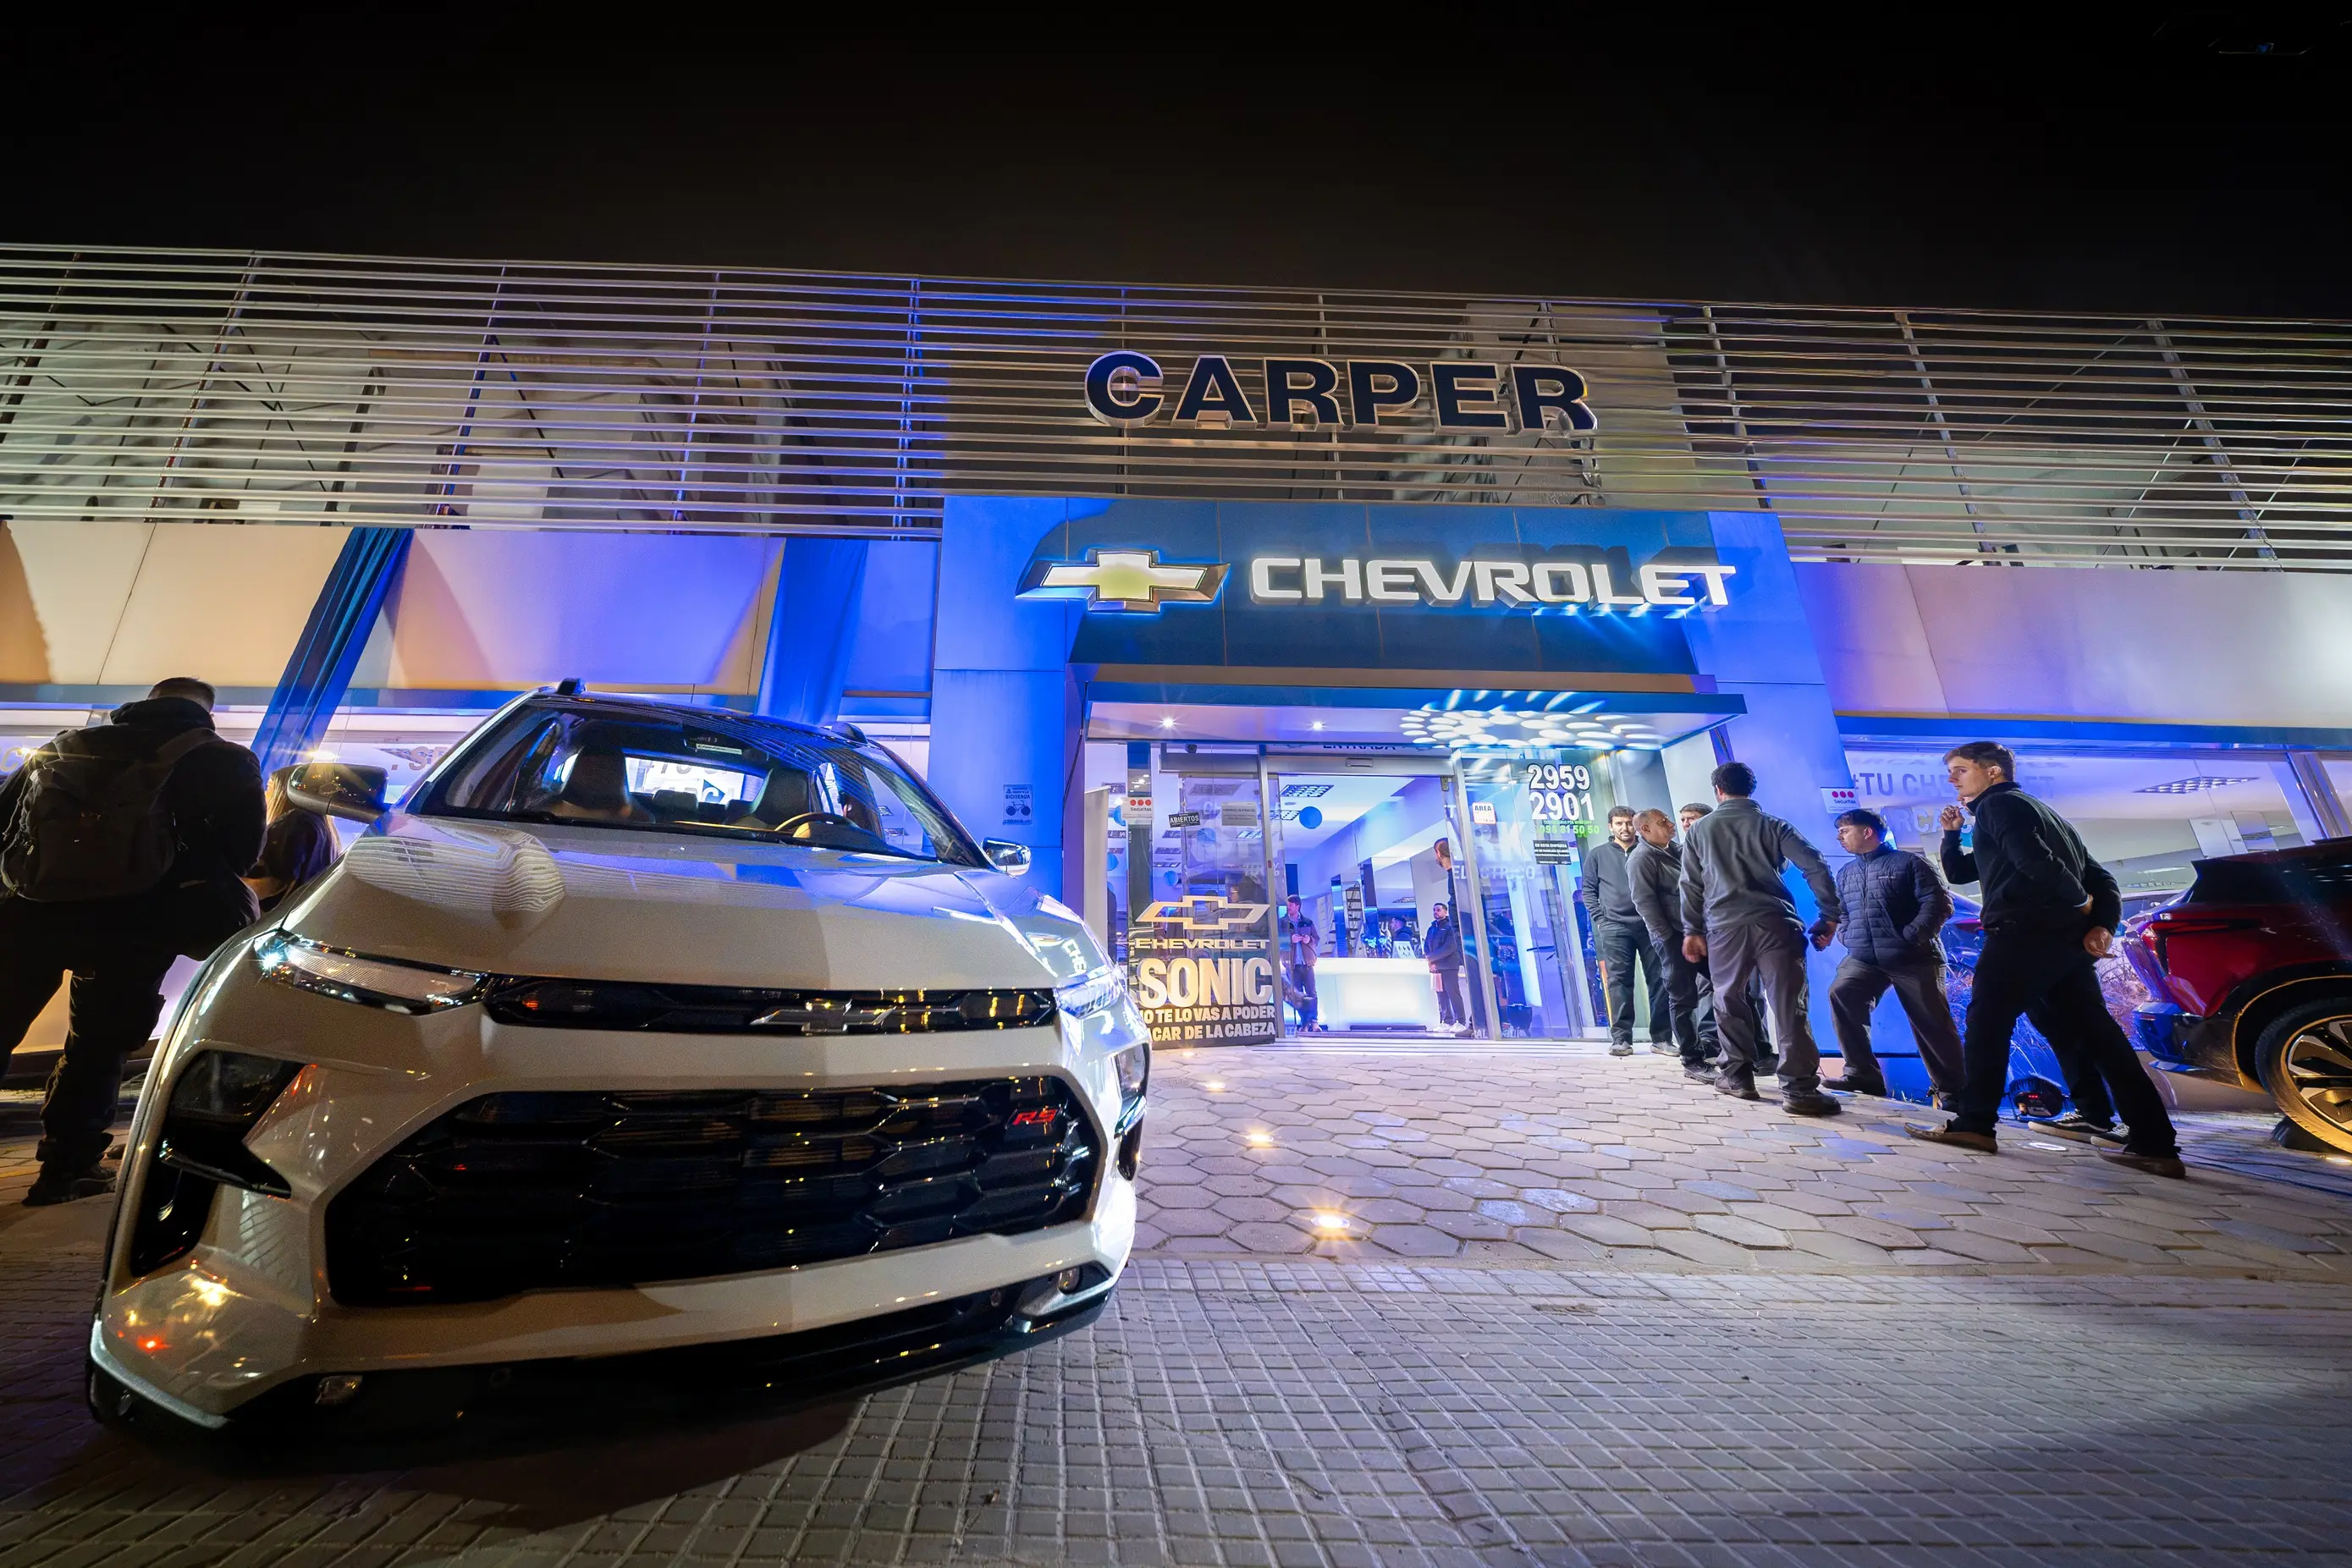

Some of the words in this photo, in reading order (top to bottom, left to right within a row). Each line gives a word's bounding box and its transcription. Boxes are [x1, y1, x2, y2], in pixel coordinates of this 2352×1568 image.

[1084, 349, 1598, 438] CARPER
[1251, 558, 1737, 609] CHEVROLET
[1527, 764, 1590, 790] 2959
[1529, 791, 1595, 821] 2901
[1170, 815, 1199, 824] ABIERTOS
[1573, 824, 1585, 834] 50
[1587, 824, 1600, 834] 50
[1135, 938, 1270, 949] CHEVROLET
[1137, 957, 1273, 1009] SONIC
[1154, 1009, 1173, 1024] TE
[1174, 1008, 1193, 1023] LO
[1193, 1007, 1220, 1021] VAS
[1221, 1007, 1232, 1021] A
[1232, 1005, 1275, 1020] PODER
[1146, 1026, 1182, 1042] CAR
[1184, 1025, 1204, 1040] DE
[1205, 1024, 1224, 1038] LA
[1225, 1021, 1275, 1037] CABEZA
[1012, 1109, 1058, 1125] RS
